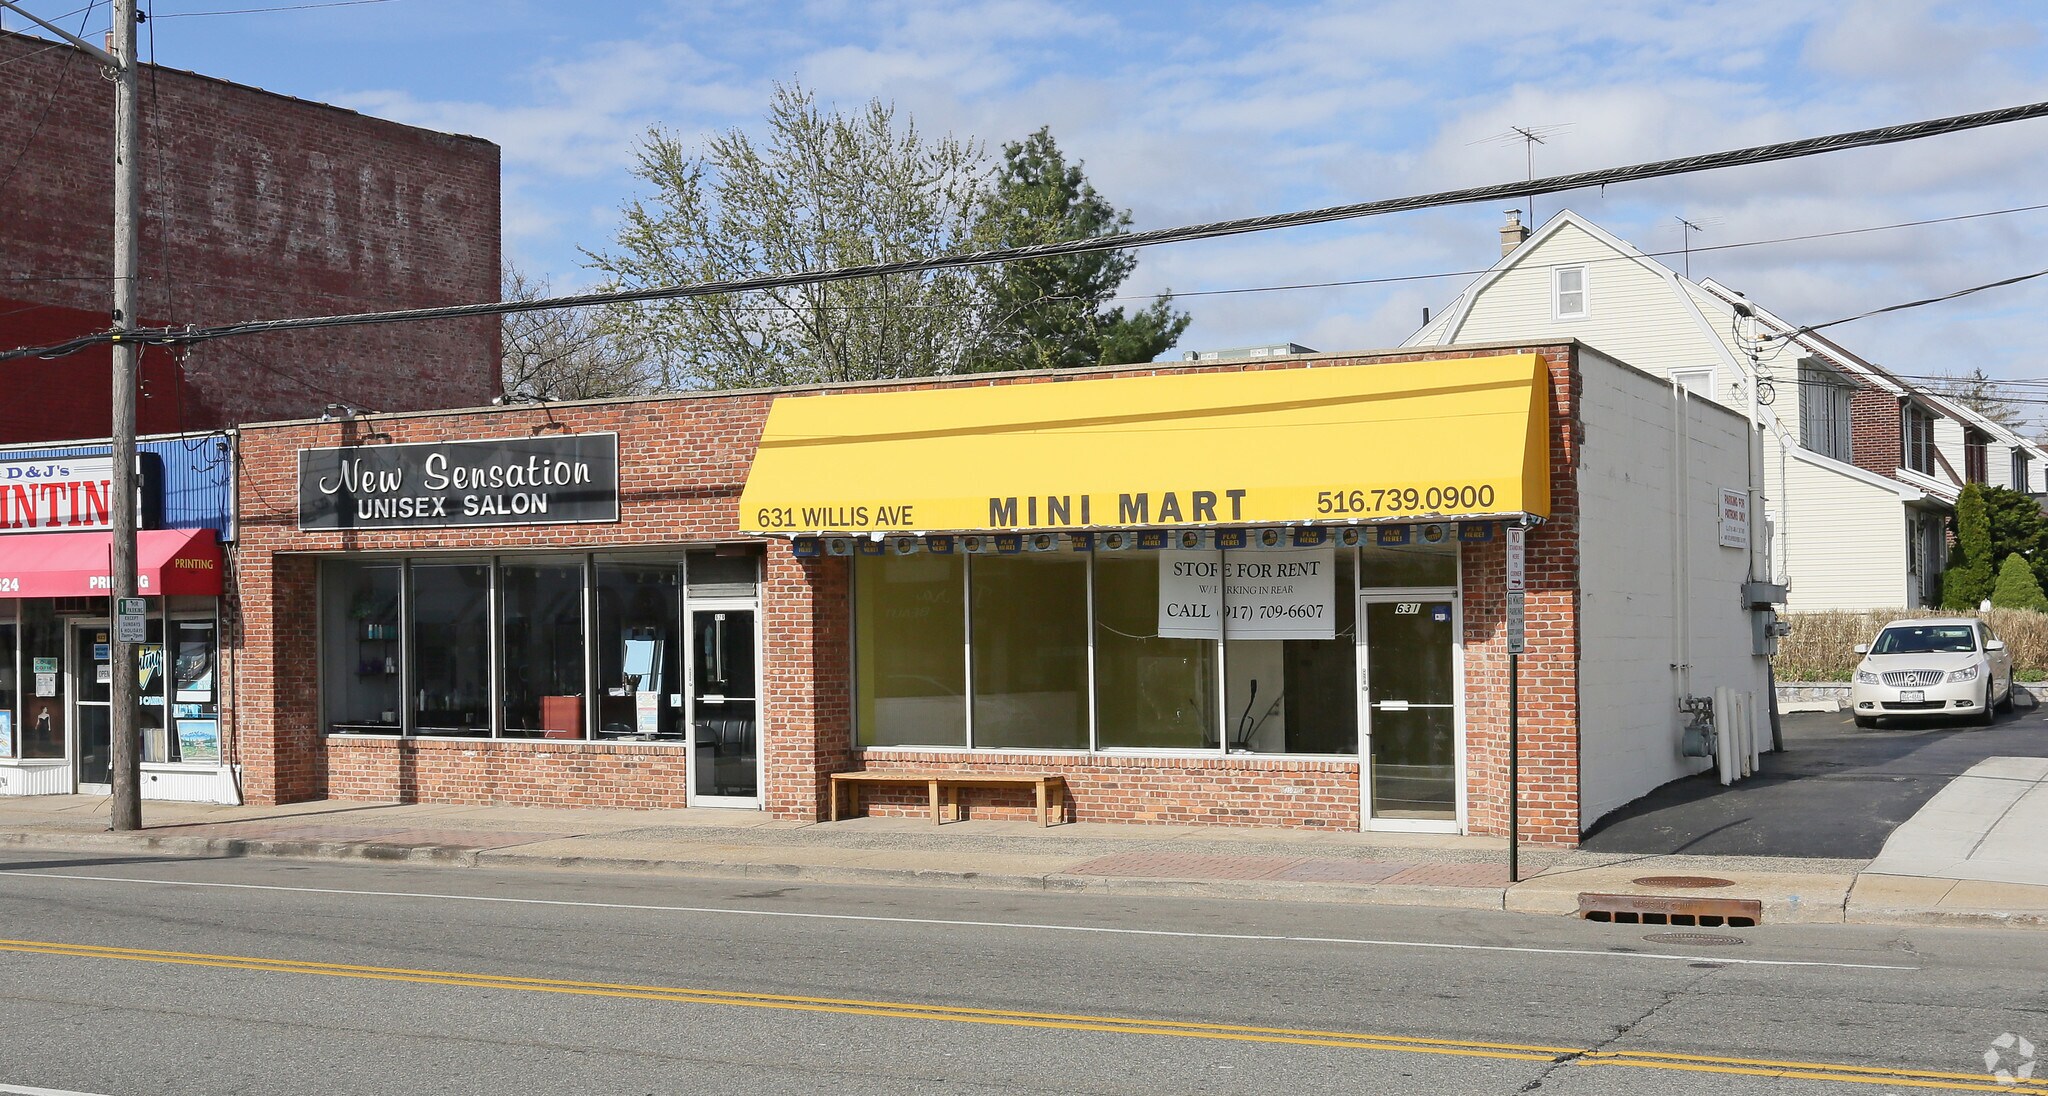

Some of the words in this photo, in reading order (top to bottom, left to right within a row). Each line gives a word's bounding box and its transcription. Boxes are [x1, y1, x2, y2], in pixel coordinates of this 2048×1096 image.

[6, 465, 70, 479] D&J's
[318, 457, 402, 495] New
[423, 452, 591, 491] Sensation
[357, 497, 447, 520] UNISEX
[463, 493, 548, 516] SALON
[1316, 484, 1495, 514] 516.739.0900
[1724, 494, 1738, 507] PARKING
[989, 494, 1090, 527] MINI
[1119, 489, 1247, 524] MART
[757, 507, 796, 528] 631
[802, 506, 869, 527] WILLIS
[875, 505, 913, 526] AVE
[1511, 532, 1520, 543] NO
[175, 558, 214, 570] PRINTING
[1237, 563, 1273, 578] FOR
[1276, 561, 1321, 578] RENT
[1259, 586, 1269, 595] IN
[1271, 585, 1294, 595] REAR
[1167, 603, 1211, 618] CALL
[1259, 604, 1324, 620] 709-6607
[1396, 603, 1418, 613] 631
[98, 670, 110, 678] OPEN
